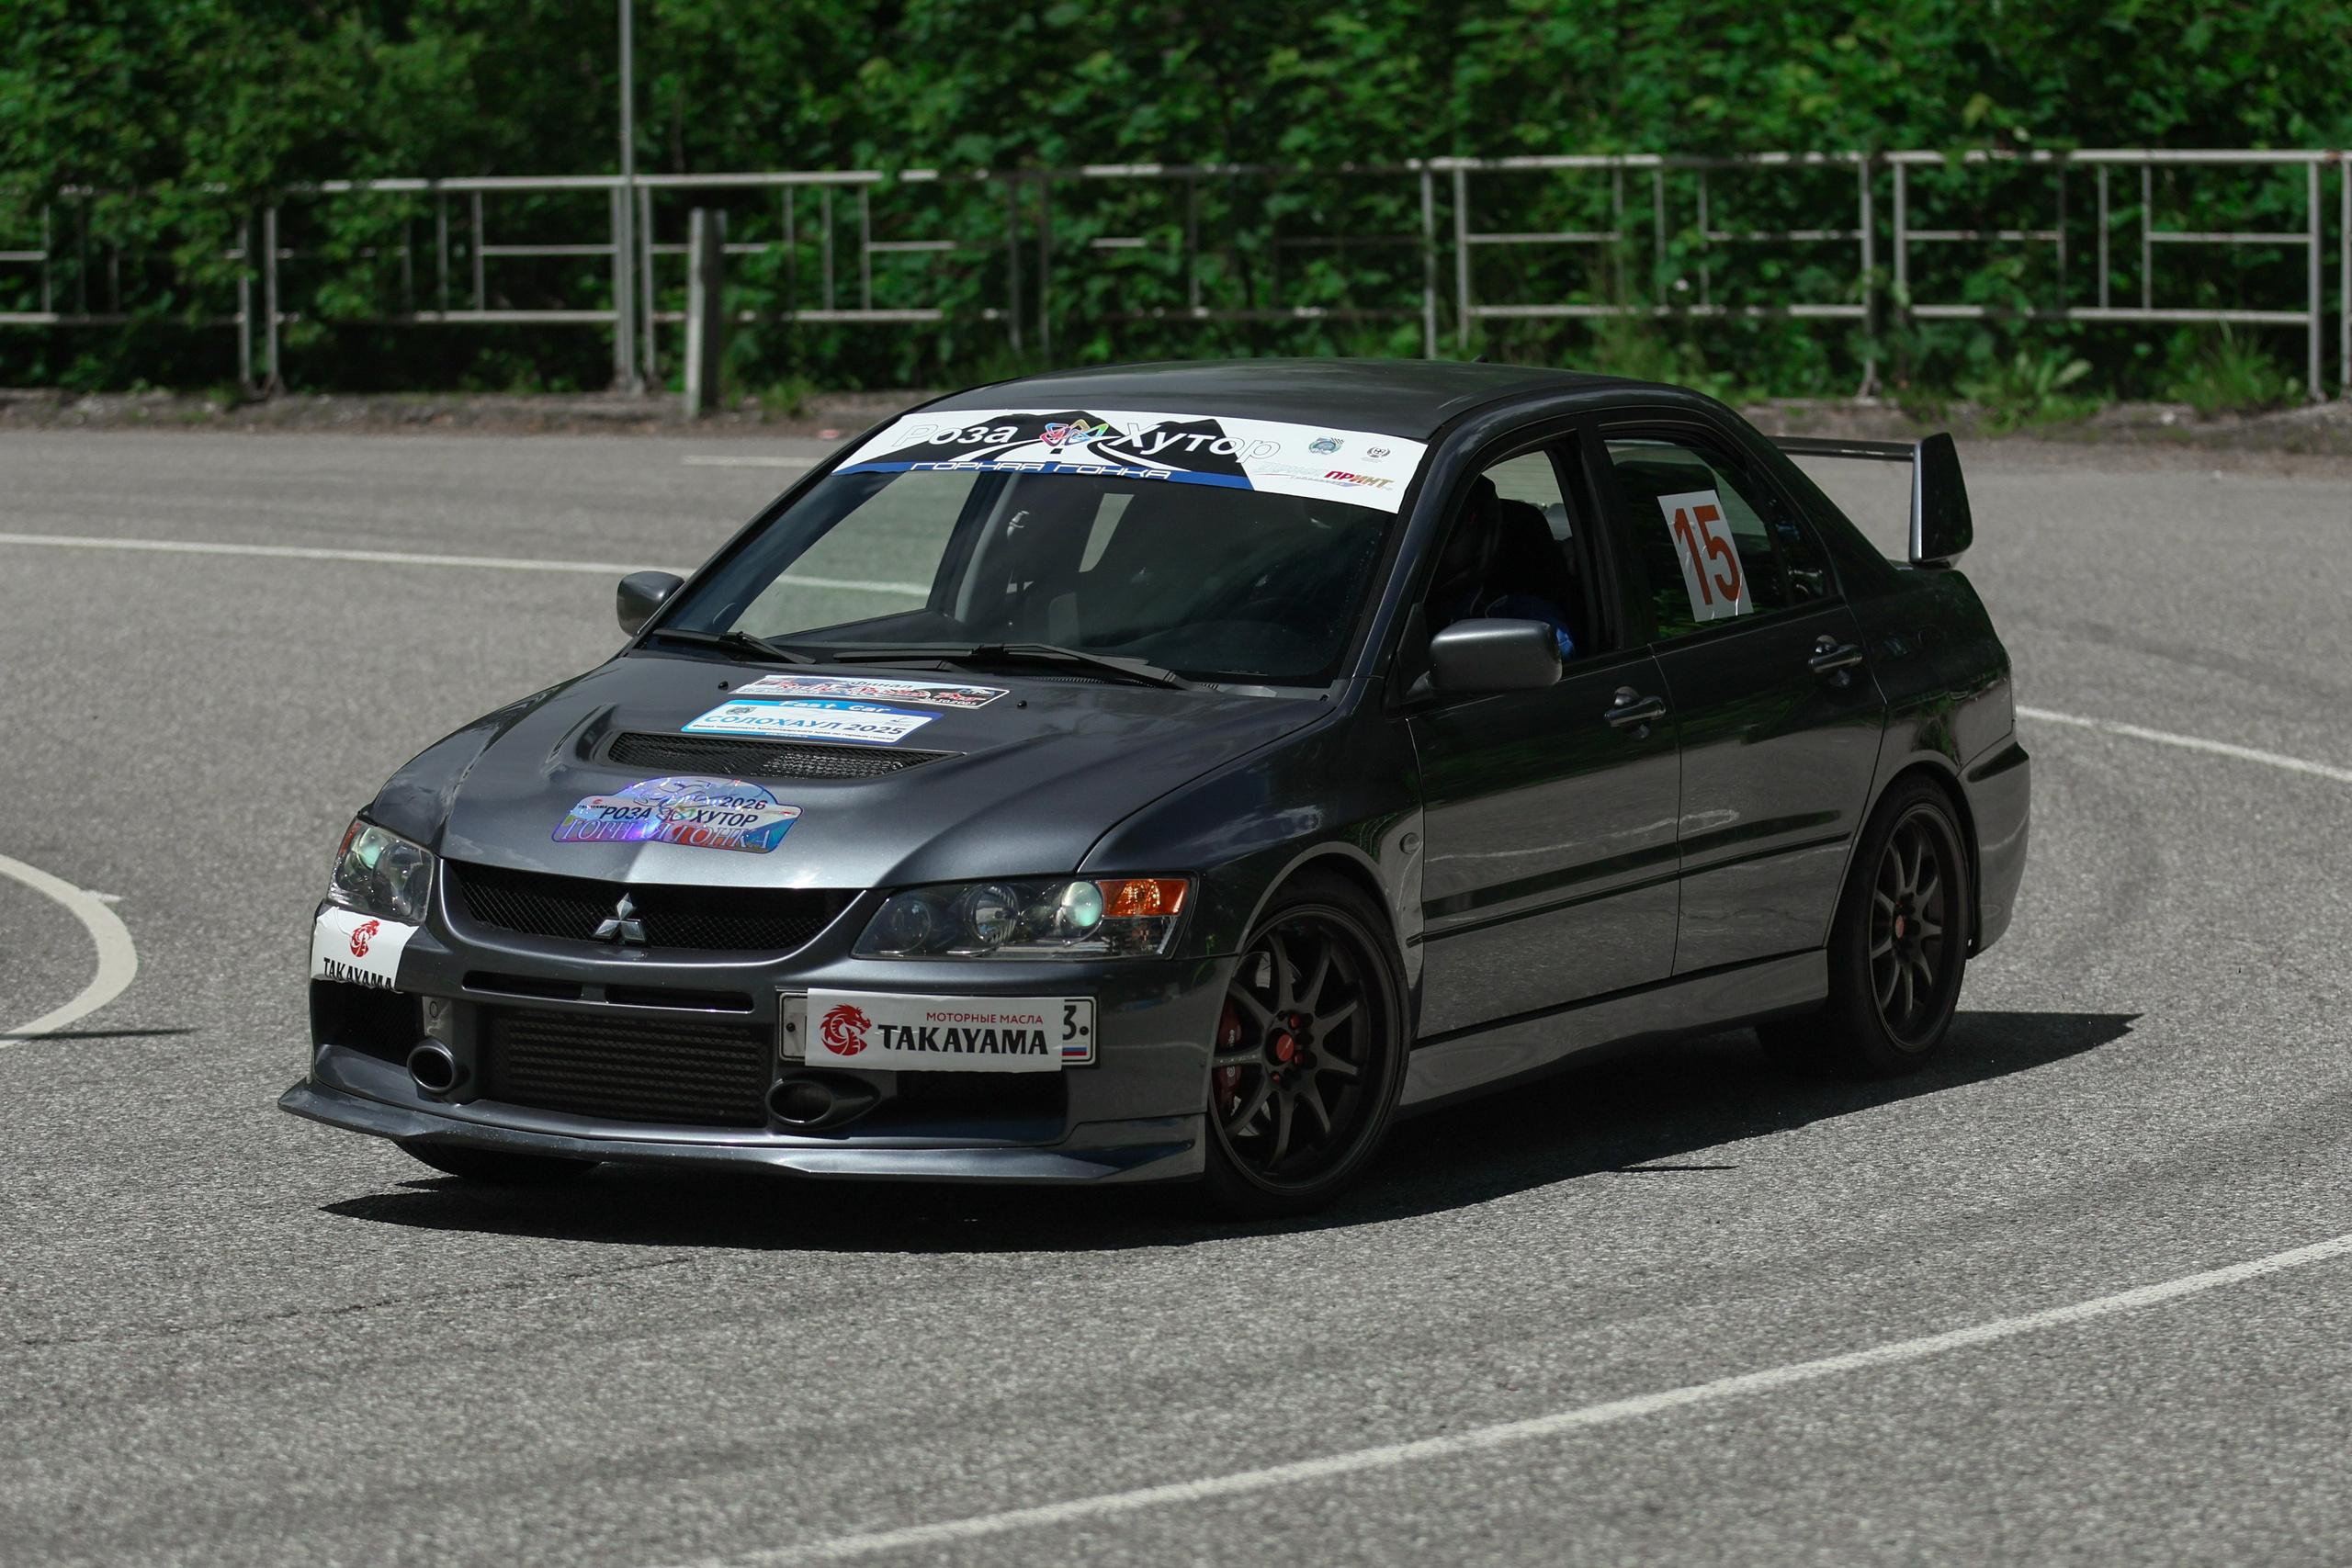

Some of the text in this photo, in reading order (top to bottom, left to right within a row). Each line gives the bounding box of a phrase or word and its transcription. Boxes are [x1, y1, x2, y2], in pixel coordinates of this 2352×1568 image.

[892, 423, 1282, 463] Роза Хутор
[910, 461, 1172, 479] ГОРНАЯ ГОНКА
[1324, 470, 1395, 489] ПРИНТ
[1673, 504, 1741, 605] 15
[779, 701, 891, 713] Fast Car
[704, 716, 842, 730] СОЛОХАУЛ
[843, 723, 906, 735] 2025
[718, 796, 768, 810] 2026
[599, 807, 653, 820] РОЗА
[689, 809, 759, 827] ХУТОР
[670, 824, 771, 850] ГОНКА
[323, 957, 394, 988] TAKAYAMA
[926, 1011, 1044, 1025] МОТОРНЫЕ МАСЛА
[877, 1024, 1049, 1055] TAKAYAMA
